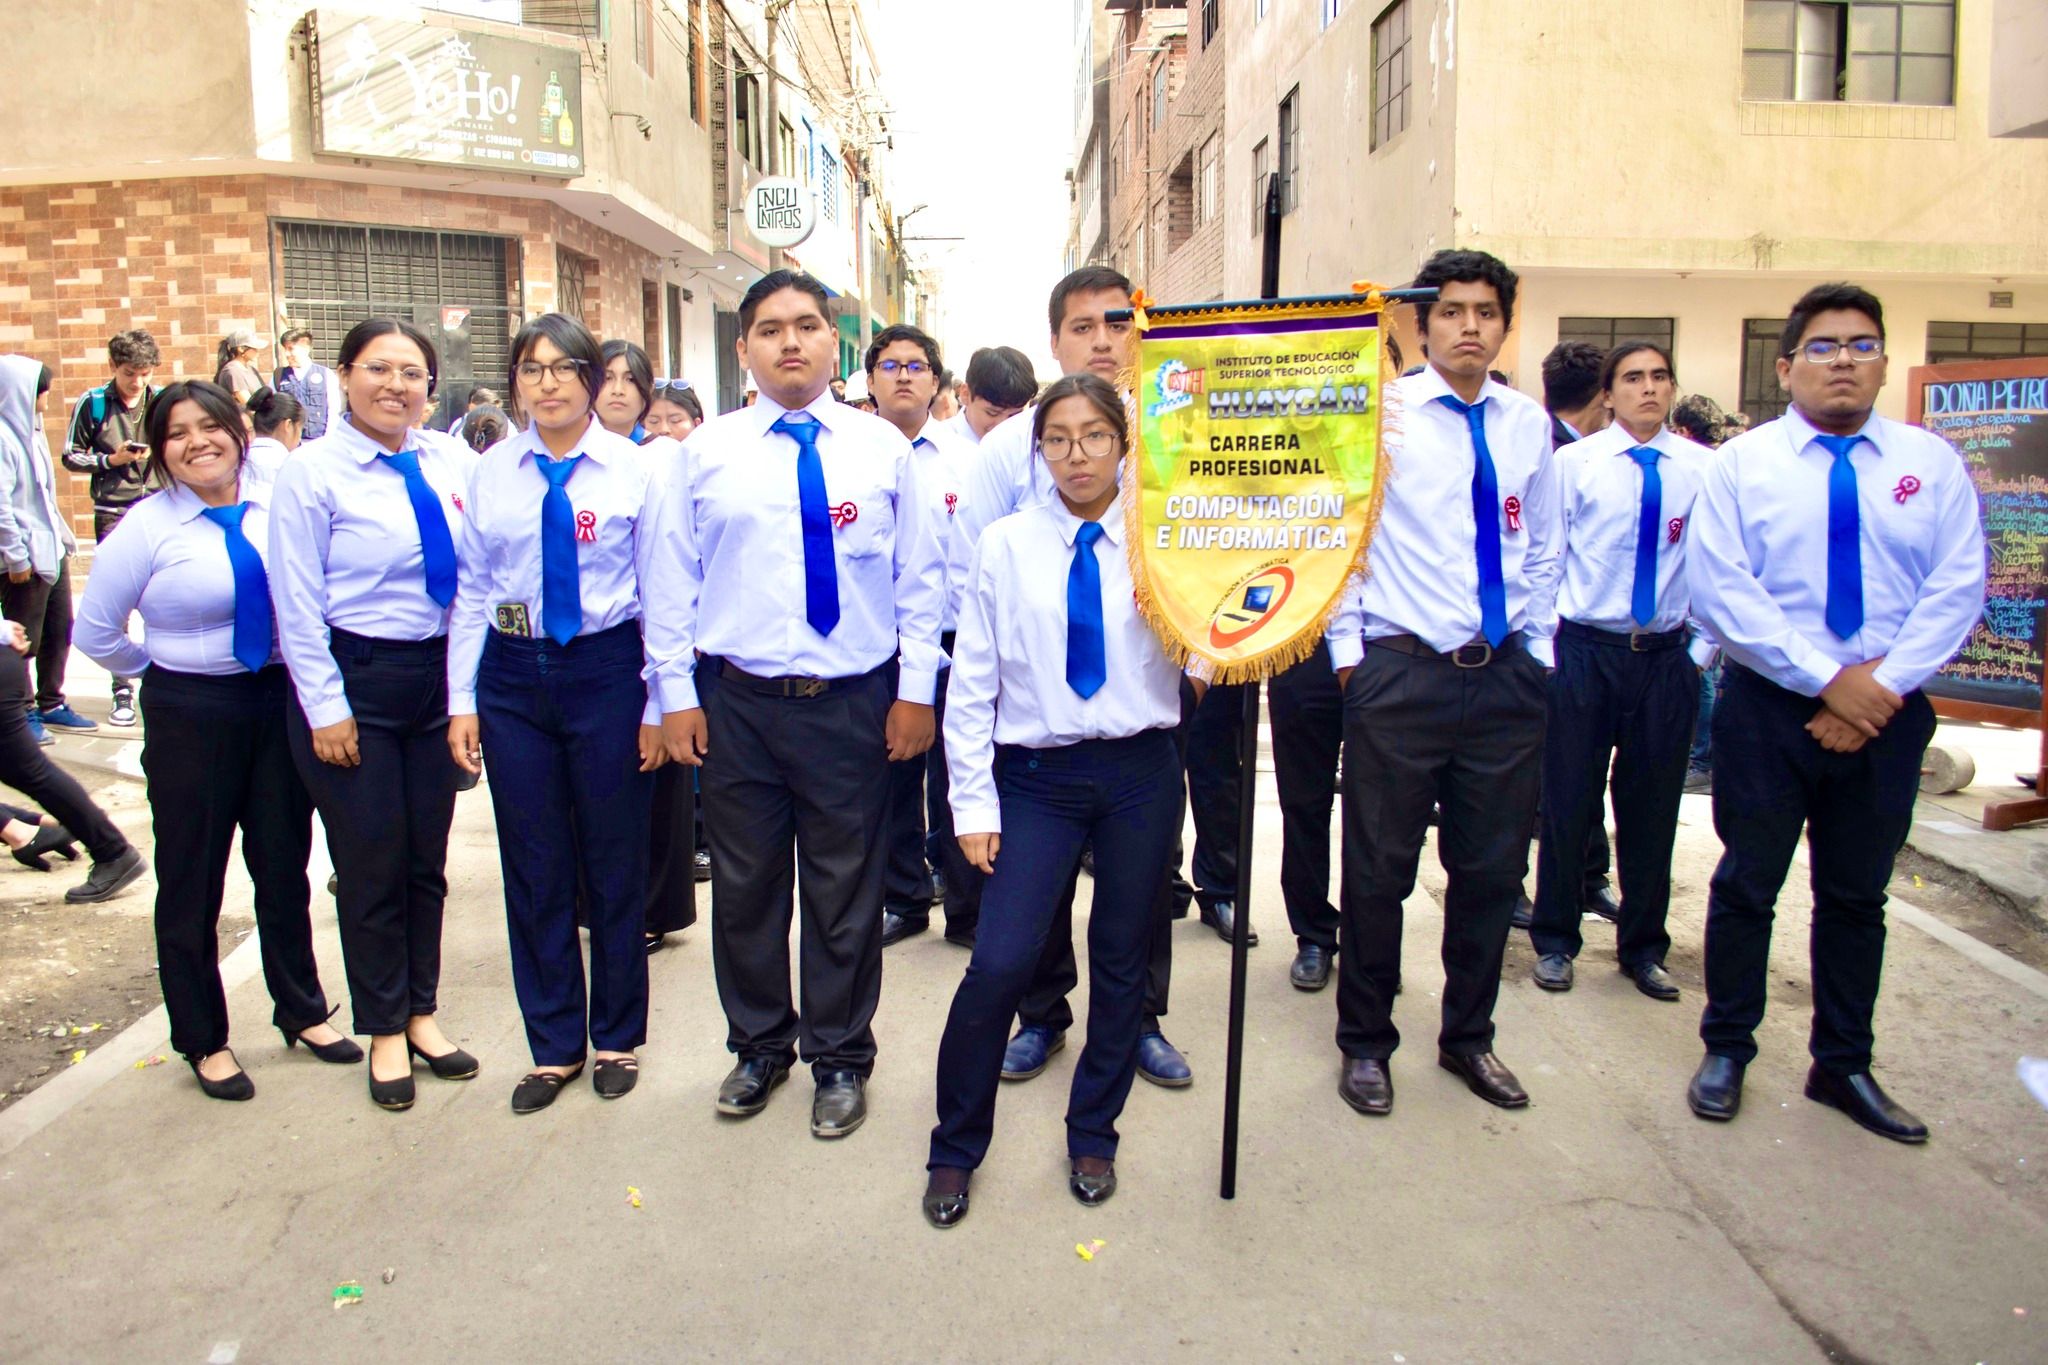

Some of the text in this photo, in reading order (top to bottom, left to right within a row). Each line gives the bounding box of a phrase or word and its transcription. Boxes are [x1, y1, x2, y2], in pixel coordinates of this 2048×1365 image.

[1215, 349, 1360, 367] INSTITUTO DE EDUCACIÓN
[1219, 364, 1355, 379] SUPERIOR TECNOLÓGICO
[1209, 379, 1368, 418] HUAYCÁN
[1930, 381, 1987, 414] DOÑA
[1210, 434, 1300, 452] CARRERA
[1190, 458, 1325, 476] PROFESIONAL
[1166, 490, 1345, 520] COMPUTACIÓN
[1156, 519, 1347, 549] E INFORMÁTICA
